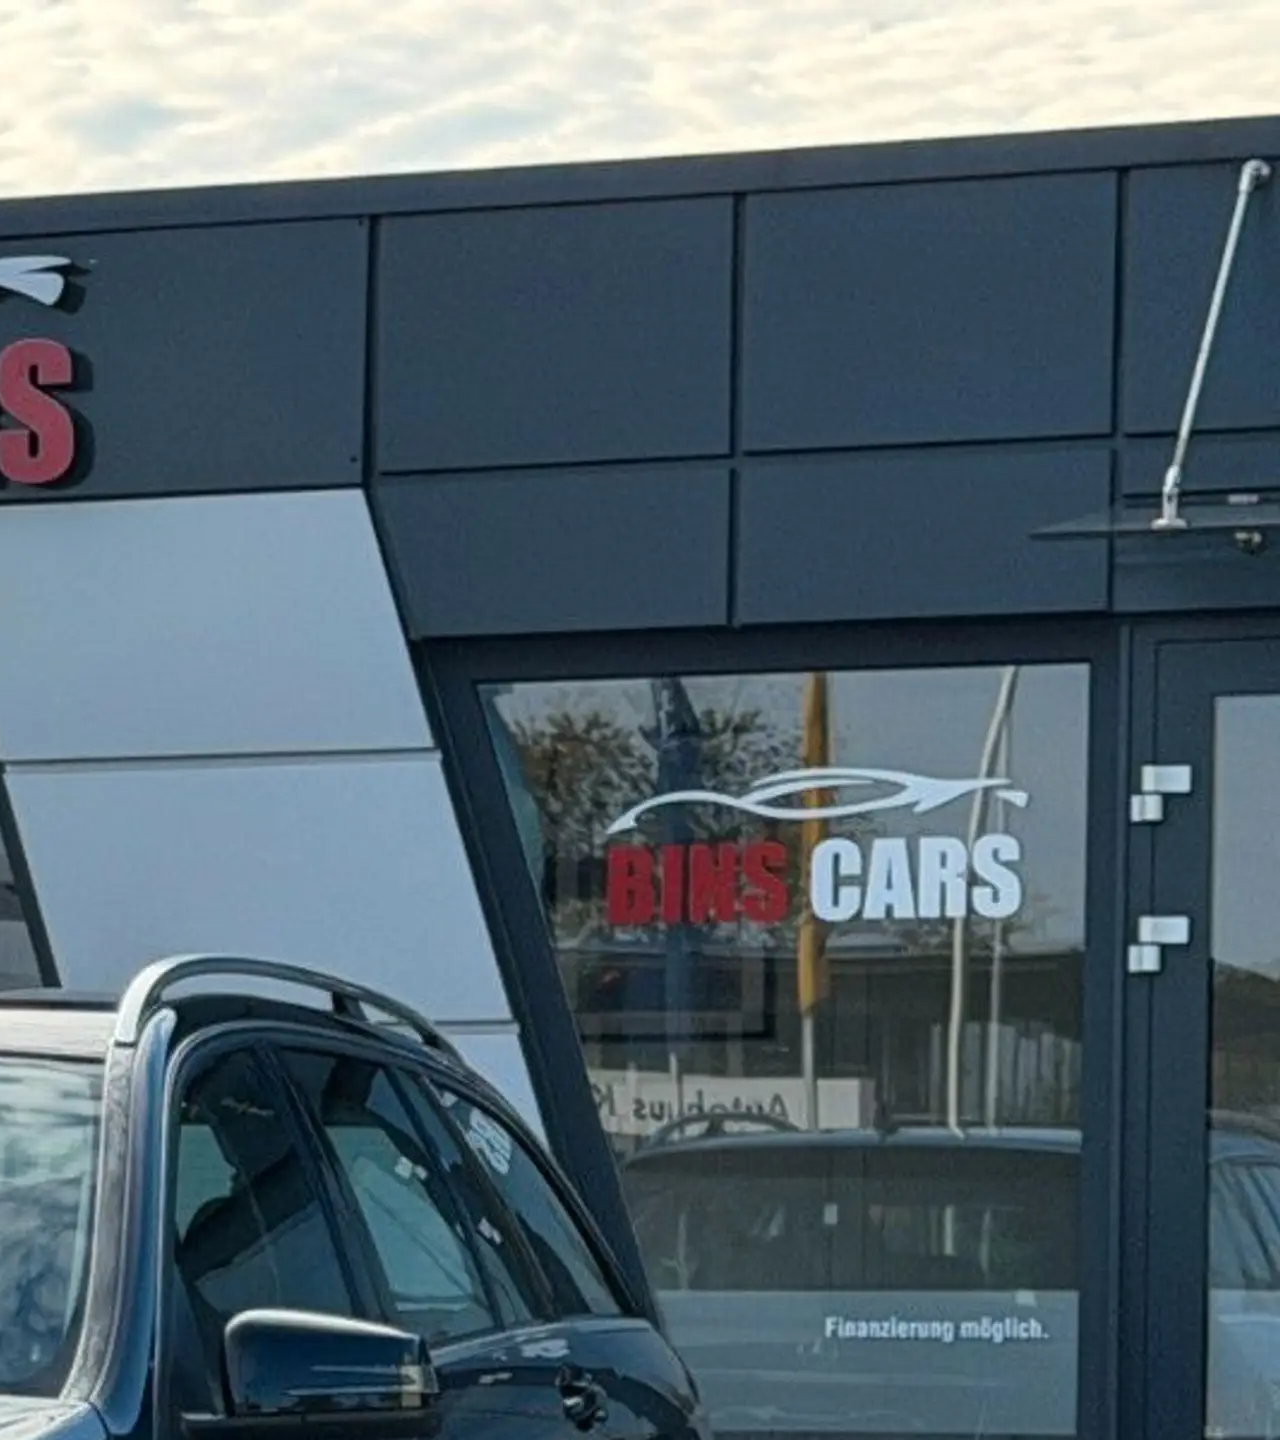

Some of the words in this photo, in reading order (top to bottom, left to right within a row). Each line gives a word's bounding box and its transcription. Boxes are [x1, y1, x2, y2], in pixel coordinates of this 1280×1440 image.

[606, 840, 789, 925] BINS
[810, 833, 1023, 922] CARS
[825, 1316, 955, 1343] Finanzierung
[959, 1316, 1051, 1344] möglich.
